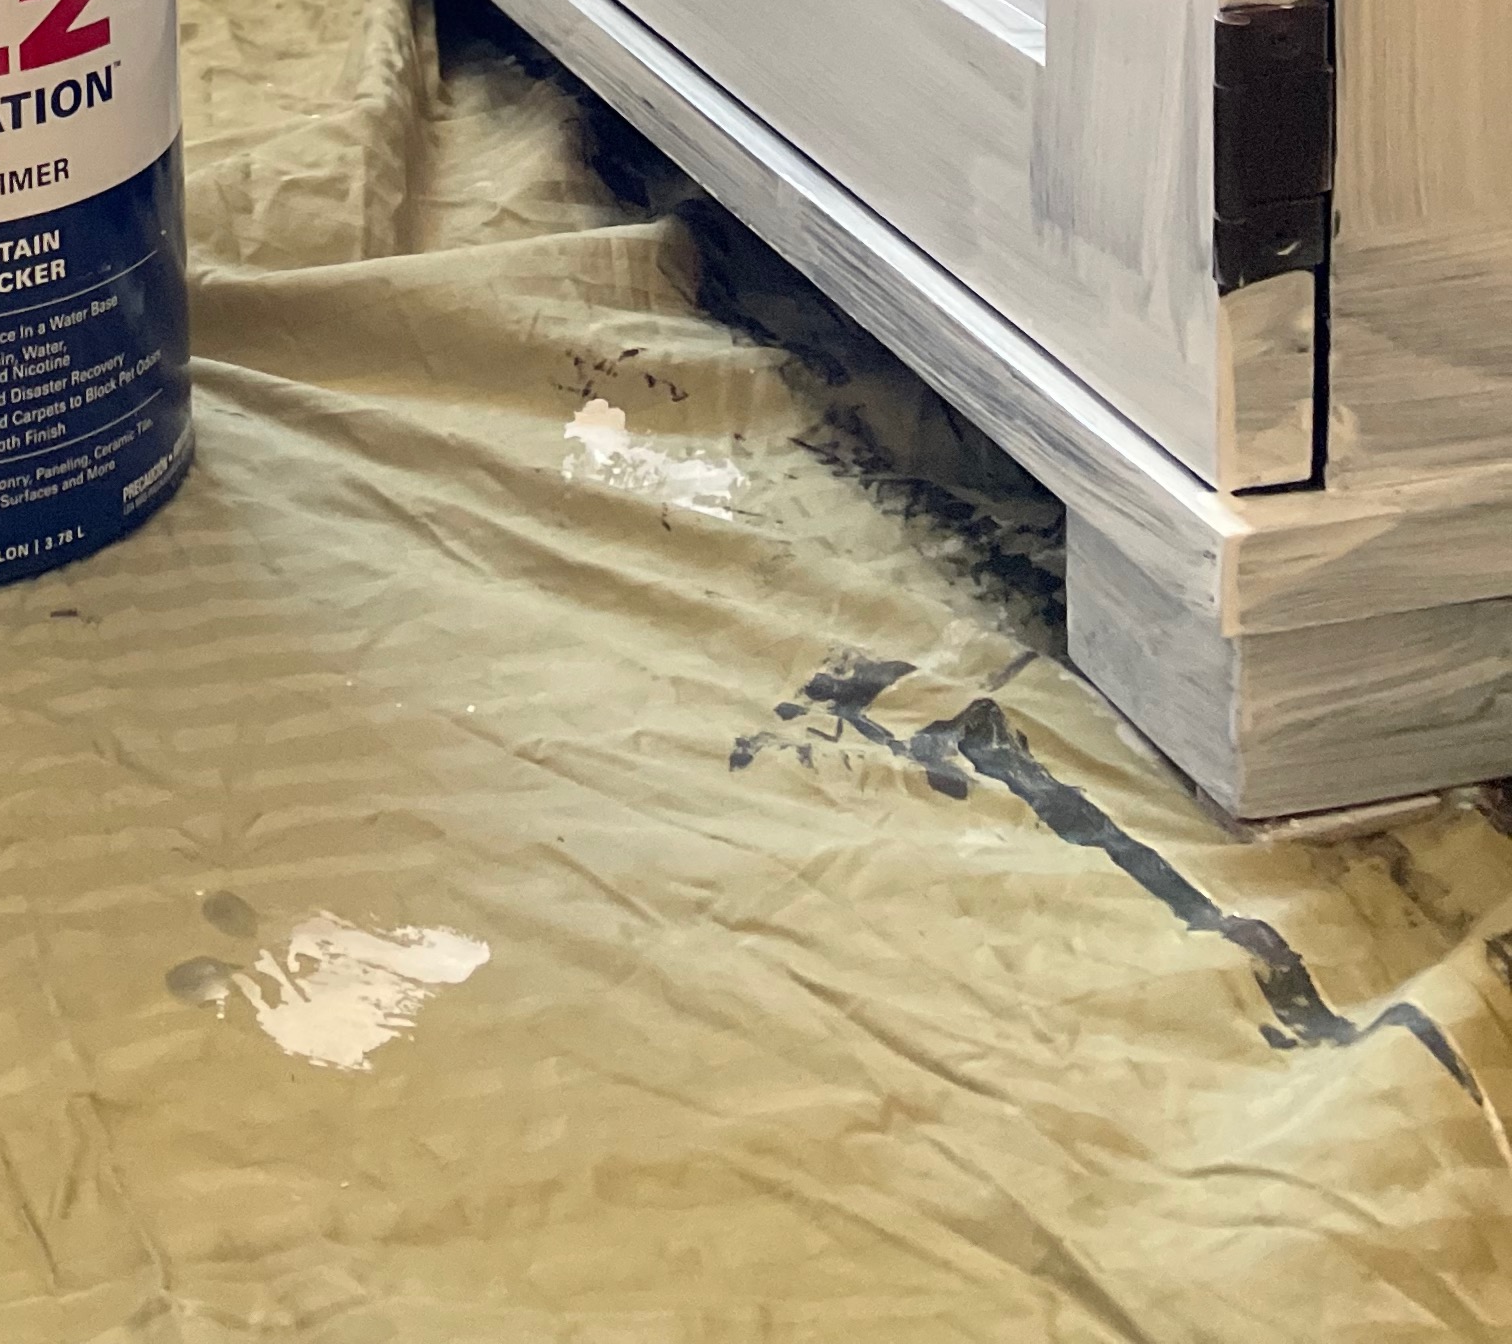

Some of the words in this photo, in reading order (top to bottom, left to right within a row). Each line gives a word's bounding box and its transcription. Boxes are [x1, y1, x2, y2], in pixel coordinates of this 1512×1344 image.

[37, 323, 46, 335] a
[49, 307, 88, 332] Water
[91, 295, 118, 317] Base
[13, 354, 71, 379] Nicotine
[22, 340, 67, 361] Water,
[11, 377, 68, 403] Disaster
[71, 353, 125, 386] Recovery
[12, 400, 66, 426] Carpets
[70, 396, 82, 409] to
[86, 379, 116, 403] Block
[119, 367, 135, 387] Pet
[25, 422, 66, 445] Finish
[35, 453, 92, 481] Paneling,
[94, 430, 135, 458] Ceramic
[0, 484, 58, 508] Surfaces
[62, 473, 84, 491] and
[87, 460, 116, 481] More
[44, 529, 74, 551] 3.78
[77, 525, 86, 539] L
